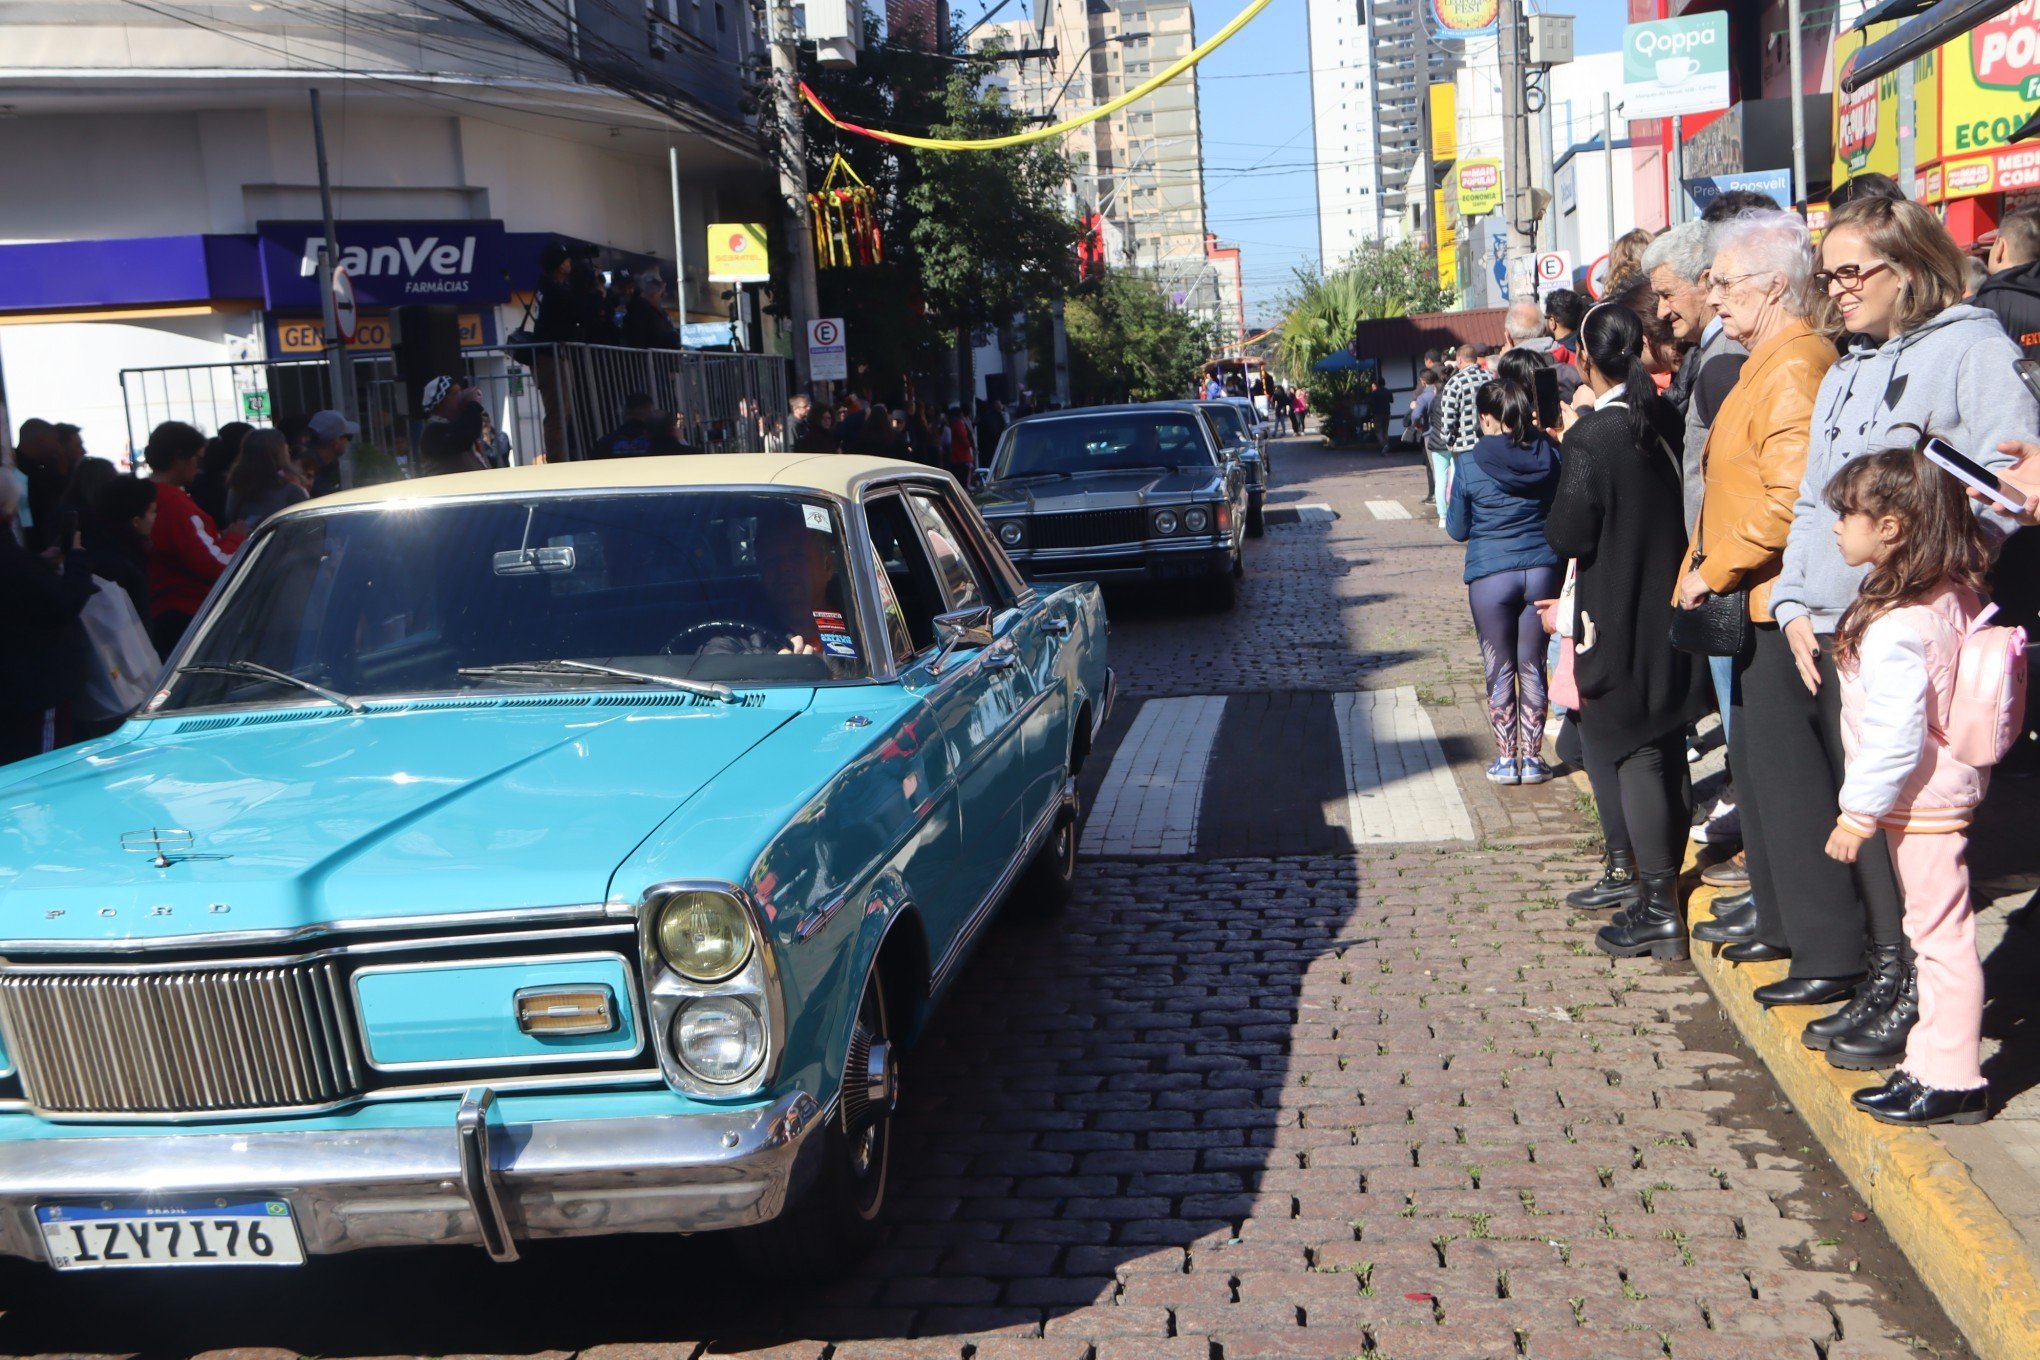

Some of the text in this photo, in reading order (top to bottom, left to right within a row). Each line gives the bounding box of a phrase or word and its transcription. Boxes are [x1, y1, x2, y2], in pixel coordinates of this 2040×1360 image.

[1454, 4, 1481, 13] FEST
[1635, 28, 1715, 57] Qoppa
[1999, 167, 2040, 187] COM
[1462, 192, 1497, 201] ECONOMIA
[1545, 259, 1556, 275] E
[405, 279, 469, 294] FARMÁCIAS
[820, 325, 832, 341] E
[45, 903, 231, 920] FORD
[146, 1207, 188, 1216] BRASIL
[69, 1219, 274, 1262] IZY7I76
